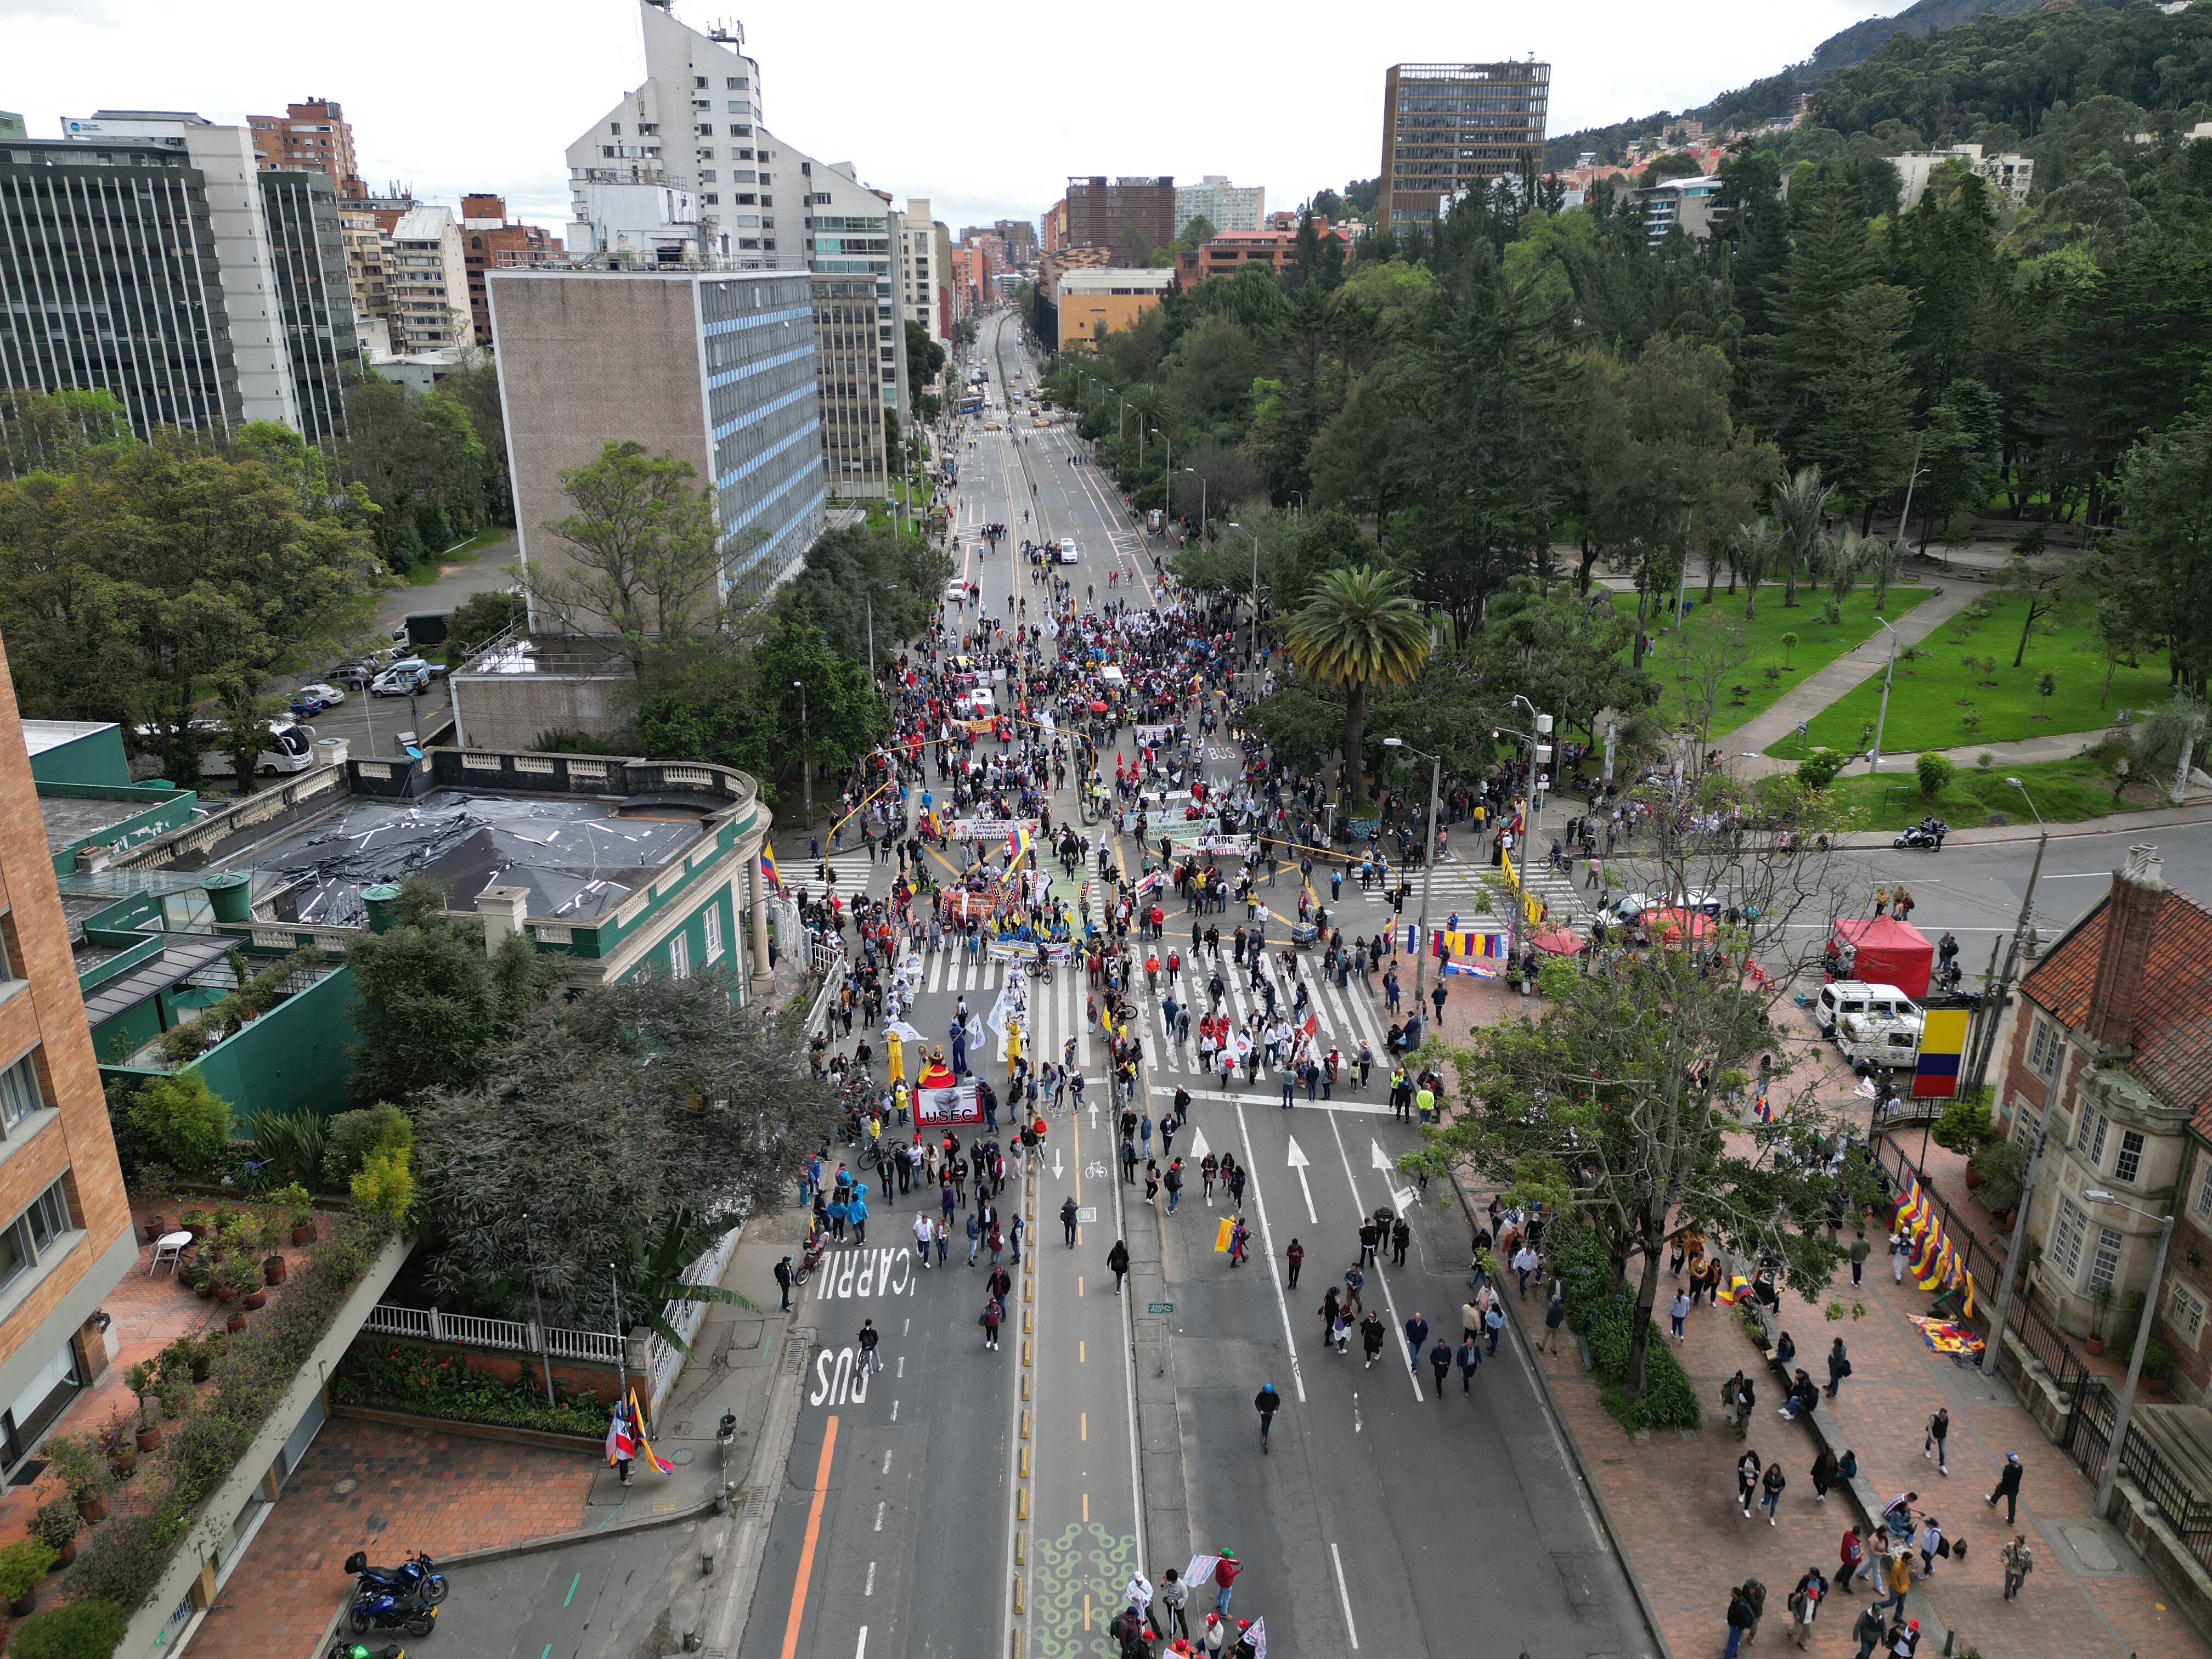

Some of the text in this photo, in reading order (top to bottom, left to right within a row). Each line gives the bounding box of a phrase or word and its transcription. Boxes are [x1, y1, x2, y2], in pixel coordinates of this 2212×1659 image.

[1208, 747, 1235, 760] BUS
[1198, 836, 1233, 847] ANHOC
[992, 882, 1002, 904] CUT
[1005, 889, 1017, 906] CUT
[889, 898, 898, 919] CUT
[926, 1109, 974, 1123] USEC
[1081, 1210, 1091, 1219] 36
[817, 1247, 911, 1300] CARRIL
[810, 1347, 873, 1407] BUS
